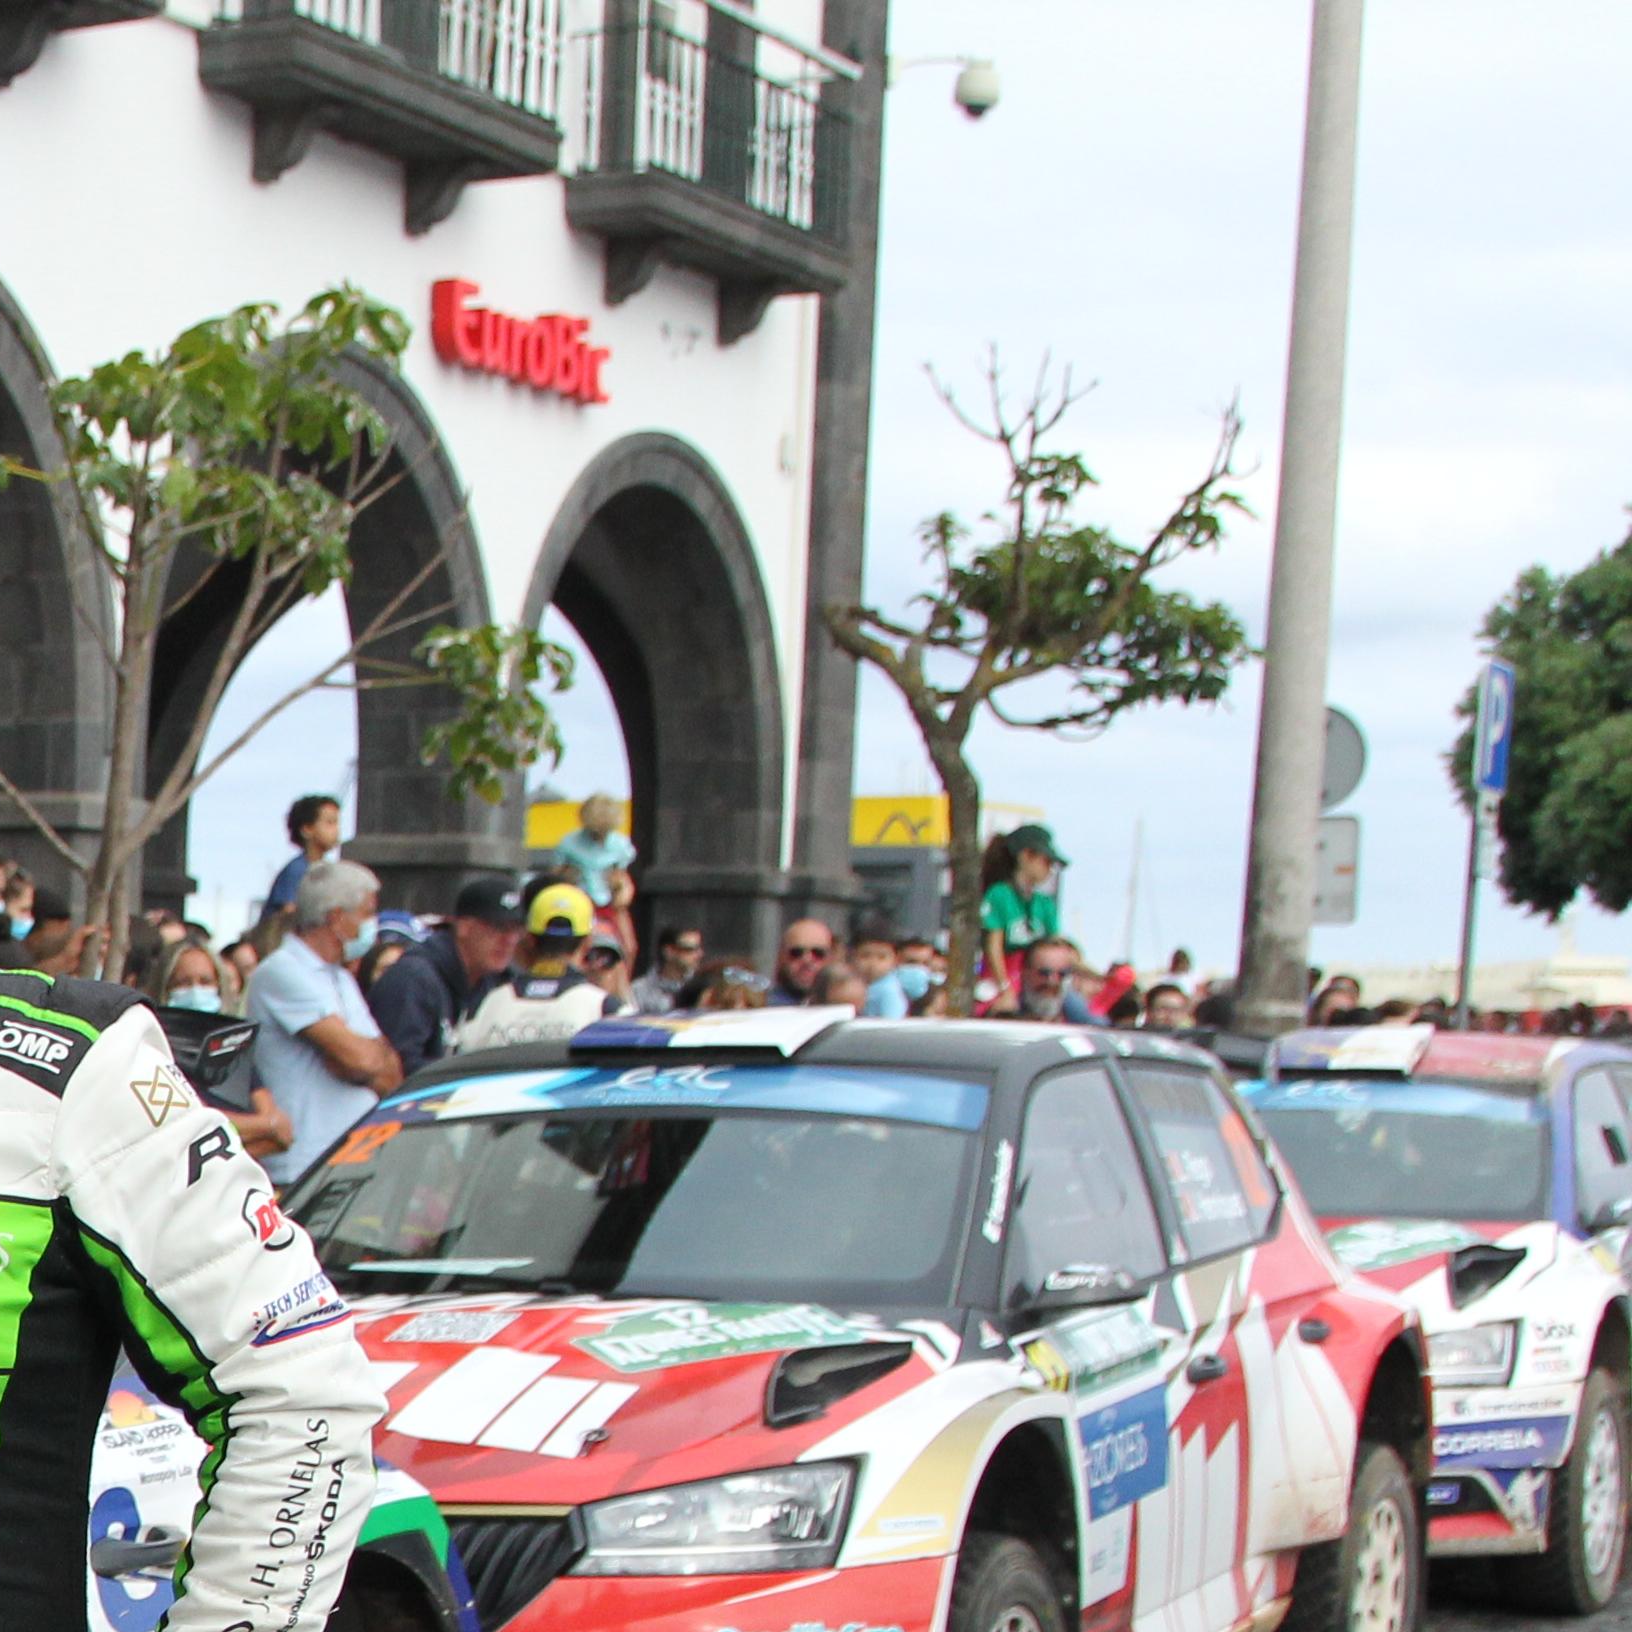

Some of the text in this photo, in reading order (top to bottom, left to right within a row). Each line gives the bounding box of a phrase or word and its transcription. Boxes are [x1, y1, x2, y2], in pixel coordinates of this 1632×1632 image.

[431, 278, 613, 405] EuroBic
[1488, 676, 1508, 778] P
[250, 1559, 285, 1588] H.
[269, 1417, 330, 1550] ORNELAS
[305, 1459, 347, 1562] ŠKODA
